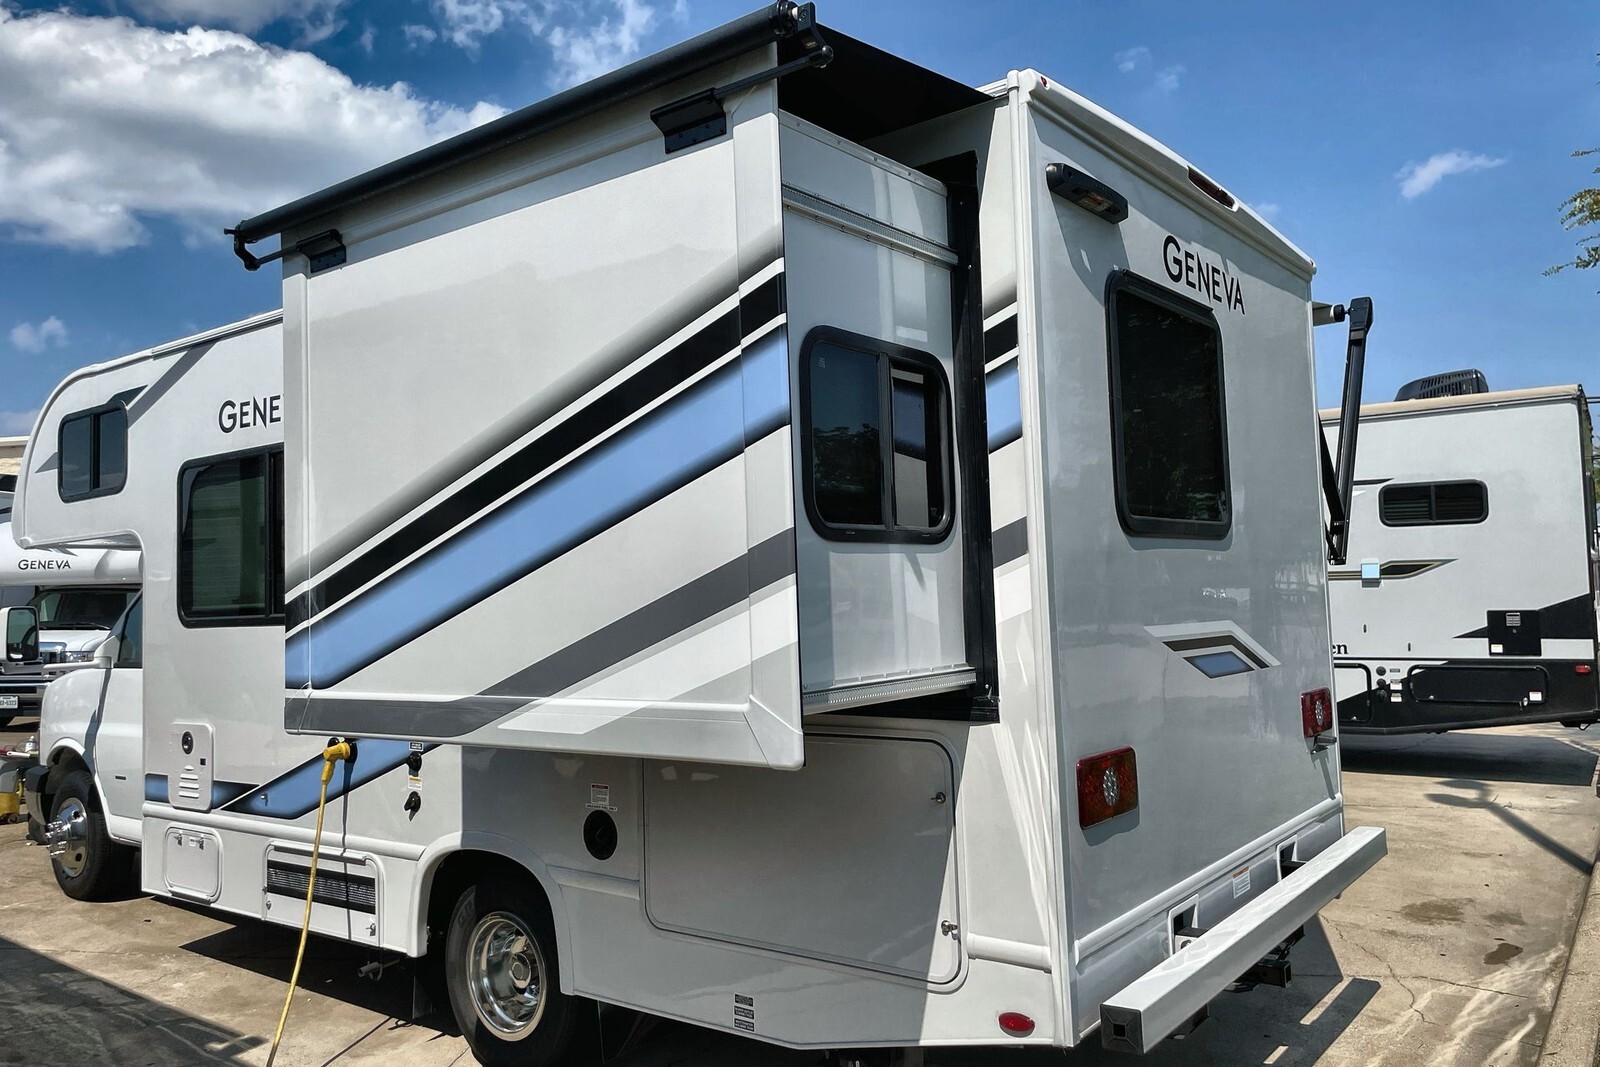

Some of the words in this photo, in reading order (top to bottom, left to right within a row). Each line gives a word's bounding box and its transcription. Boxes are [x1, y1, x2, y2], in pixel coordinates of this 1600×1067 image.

[1163, 235, 1246, 316] GENEVA
[218, 394, 282, 434] GENE
[18, 559, 71, 571] GENEVA
